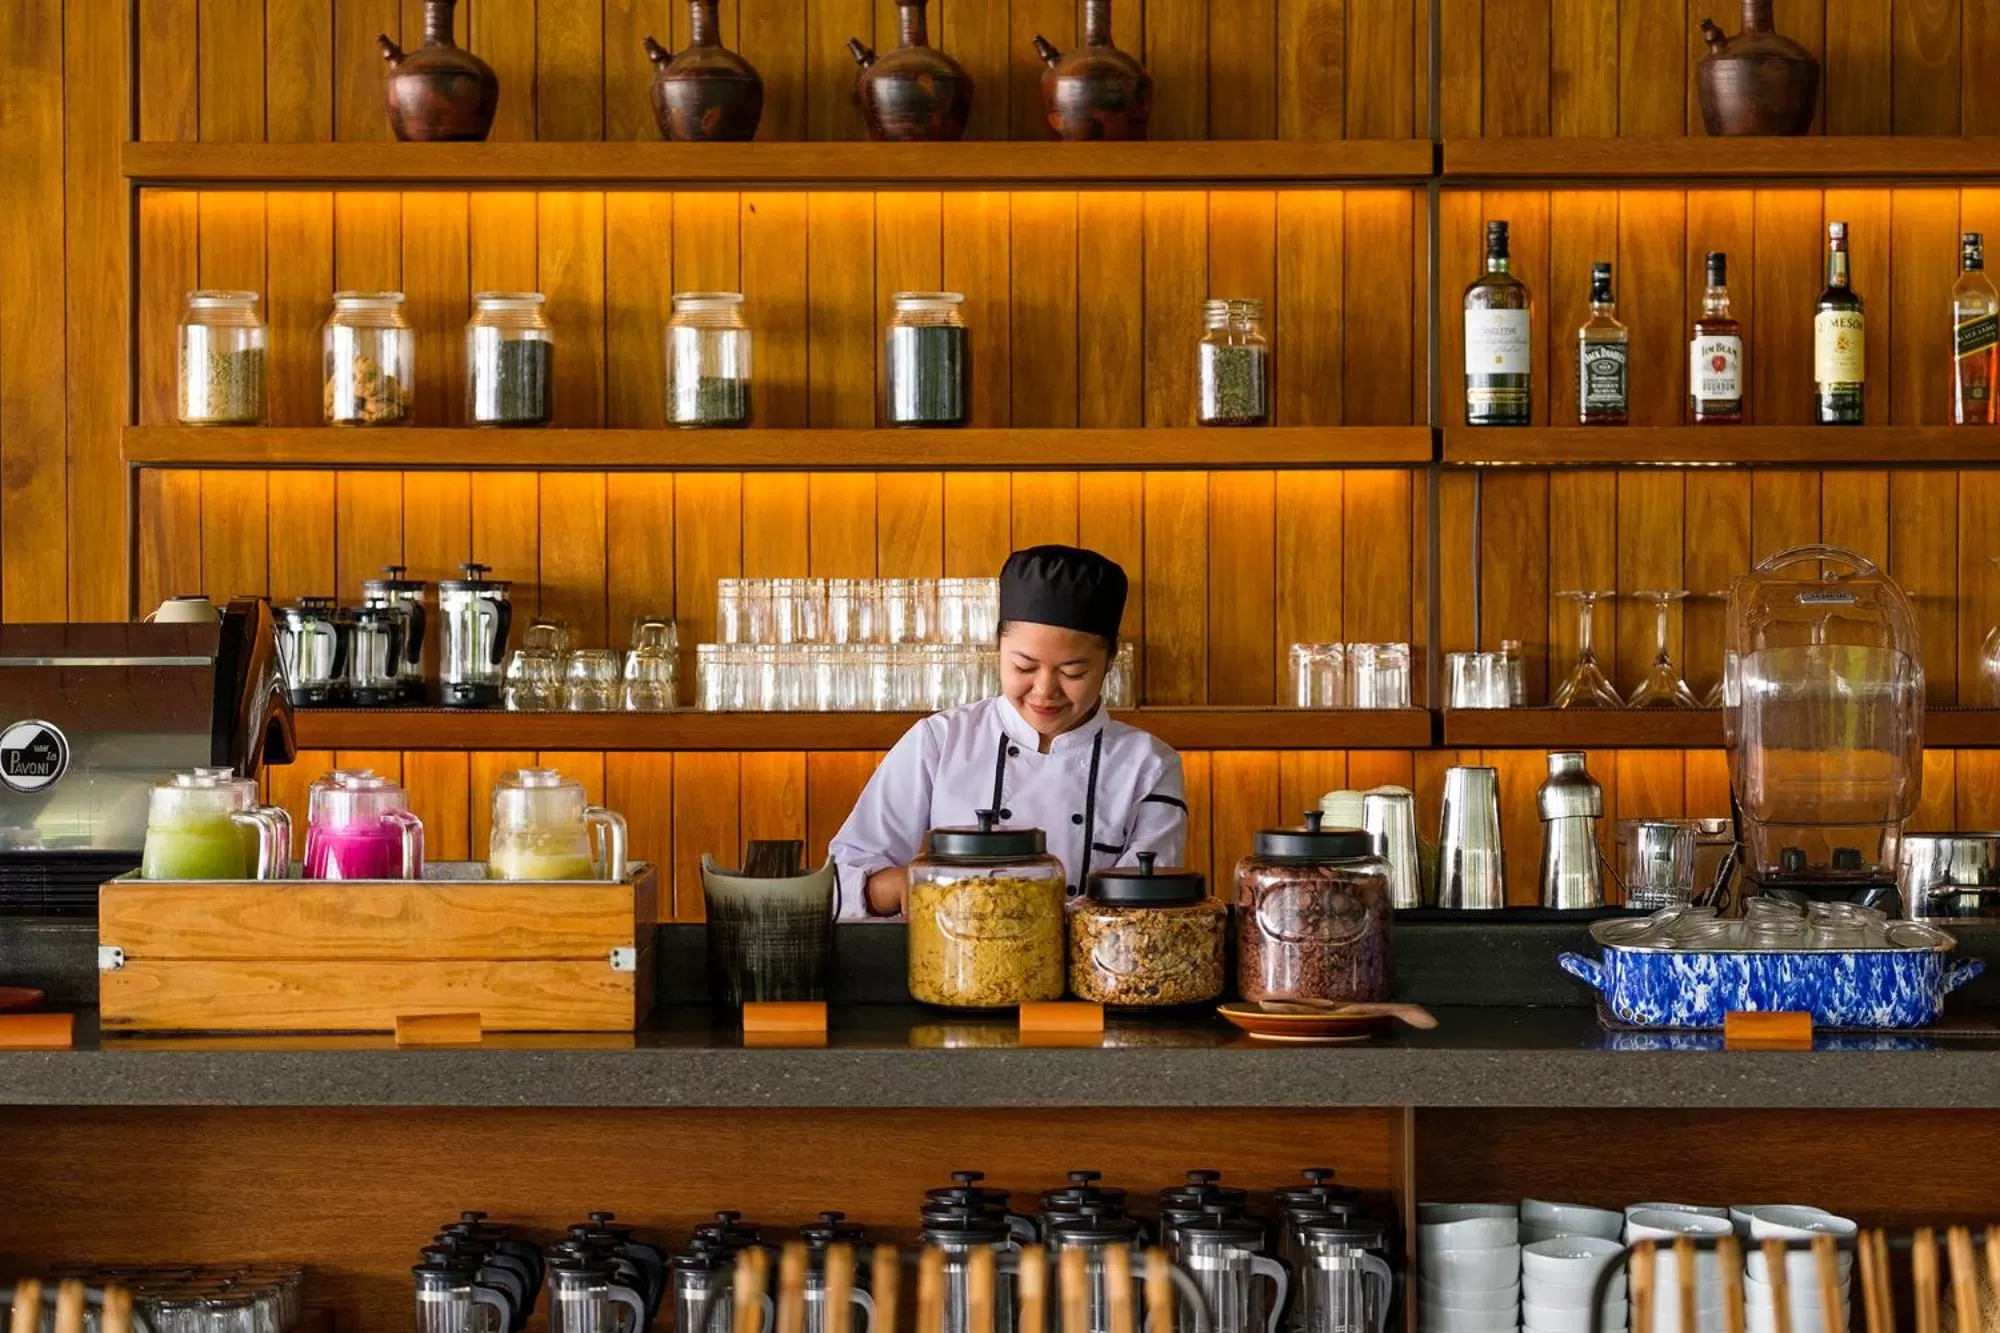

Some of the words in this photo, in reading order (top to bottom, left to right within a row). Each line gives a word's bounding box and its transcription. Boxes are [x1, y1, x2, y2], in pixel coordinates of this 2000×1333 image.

[1819, 318, 1863, 332] JMESON
[1701, 344, 1715, 358] JIM
[10, 750, 49, 774] PAVONI
